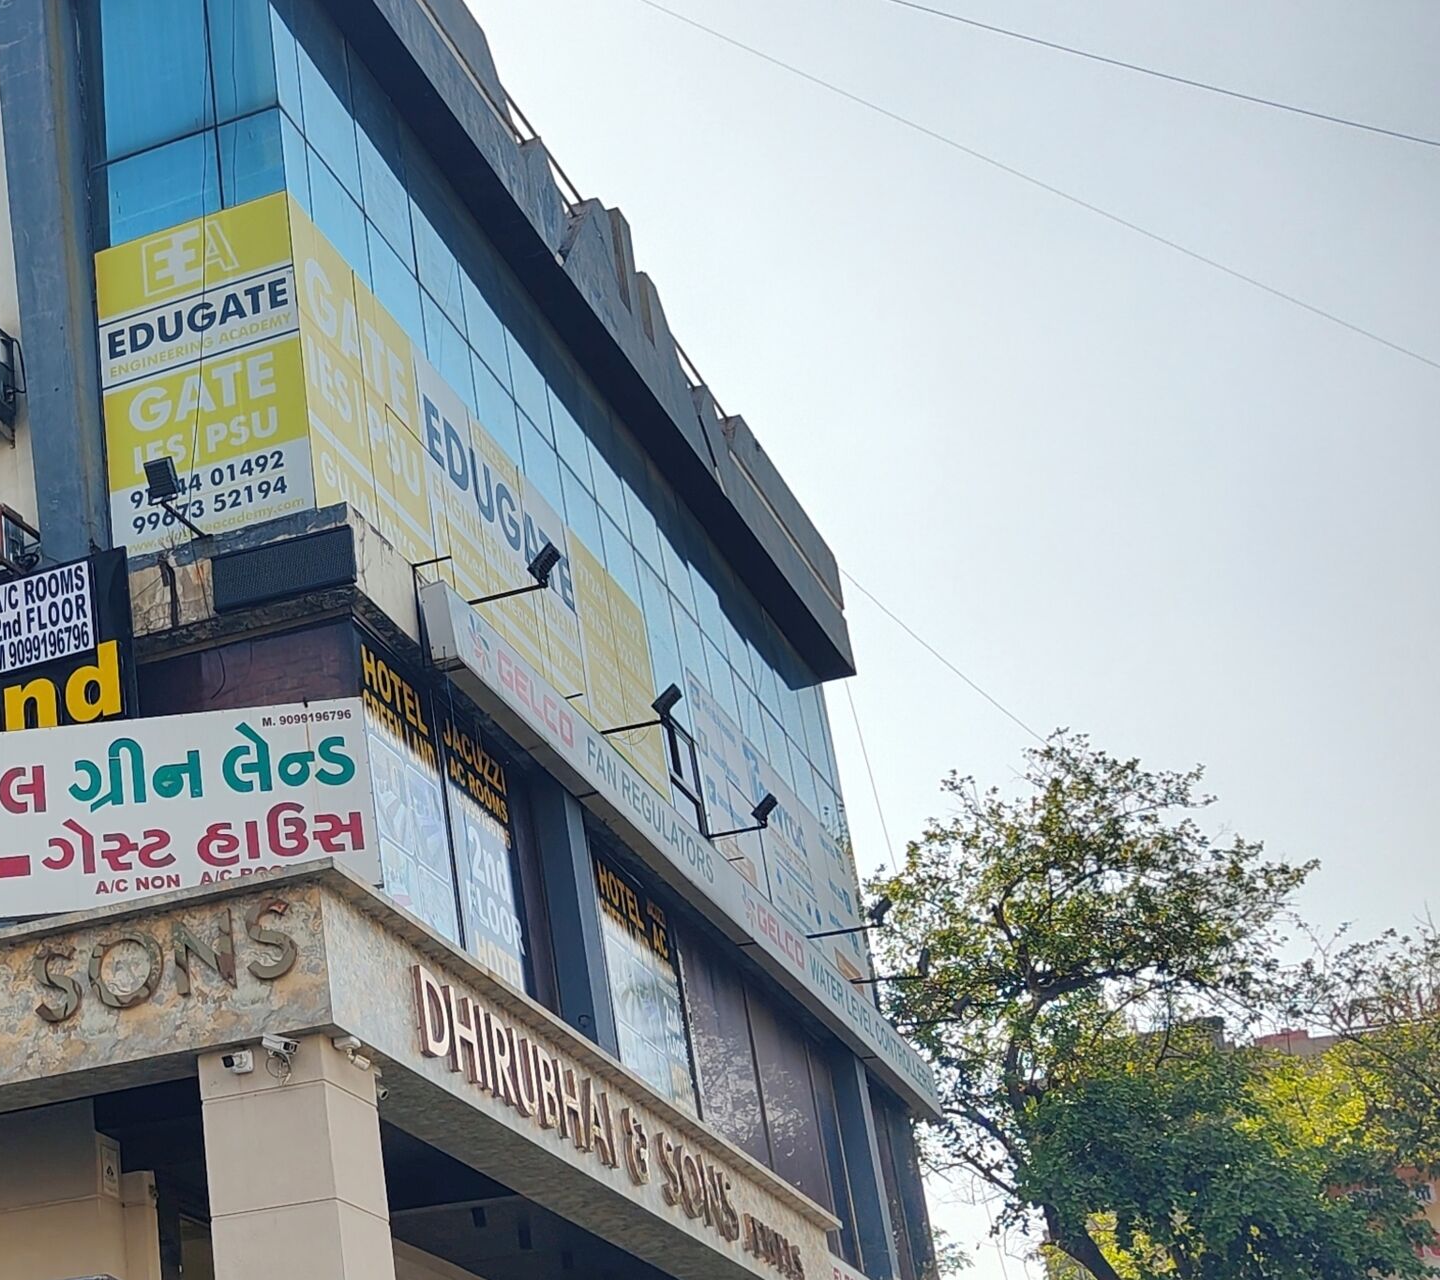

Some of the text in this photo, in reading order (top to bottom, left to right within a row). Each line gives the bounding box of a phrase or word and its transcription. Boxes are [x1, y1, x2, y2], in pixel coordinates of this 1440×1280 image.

[108, 277, 289, 359] EDUGATE
[110, 313, 292, 379] ENGINEERING ACADEMY
[305, 257, 409, 422] GATE
[129, 351, 276, 432] GATE
[207, 407, 278, 453] PSU
[210, 450, 284, 486] 01492
[214, 476, 287, 512] 52194
[24, 565, 84, 606] ROOMS
[27, 594, 87, 633] FLOOR
[9, 622, 89, 667] 9099196796
[279, 710, 352, 725] 9099196796
[360, 644, 428, 734] HOTEL
[69, 738, 202, 812] ગ્રીન
[223, 722, 356, 792] લેન્ડ
[443, 719, 507, 796] JACUZZI
[498, 651, 574, 748] GELCO
[586, 737, 621, 790] FAN
[623, 774, 716, 885] REGULATORS
[469, 772, 509, 824] ROOMS
[41, 802, 364, 873] ગેસ્ટ હાઉસ
[96, 873, 181, 894] A/C NON
[597, 859, 645, 931] HOTEL
[35, 897, 299, 1025] SONS
[757, 903, 844, 1009] GELCO WATER
[412, 964, 617, 1170] DHIRUBHAI
[655, 1132, 739, 1243] SONS
